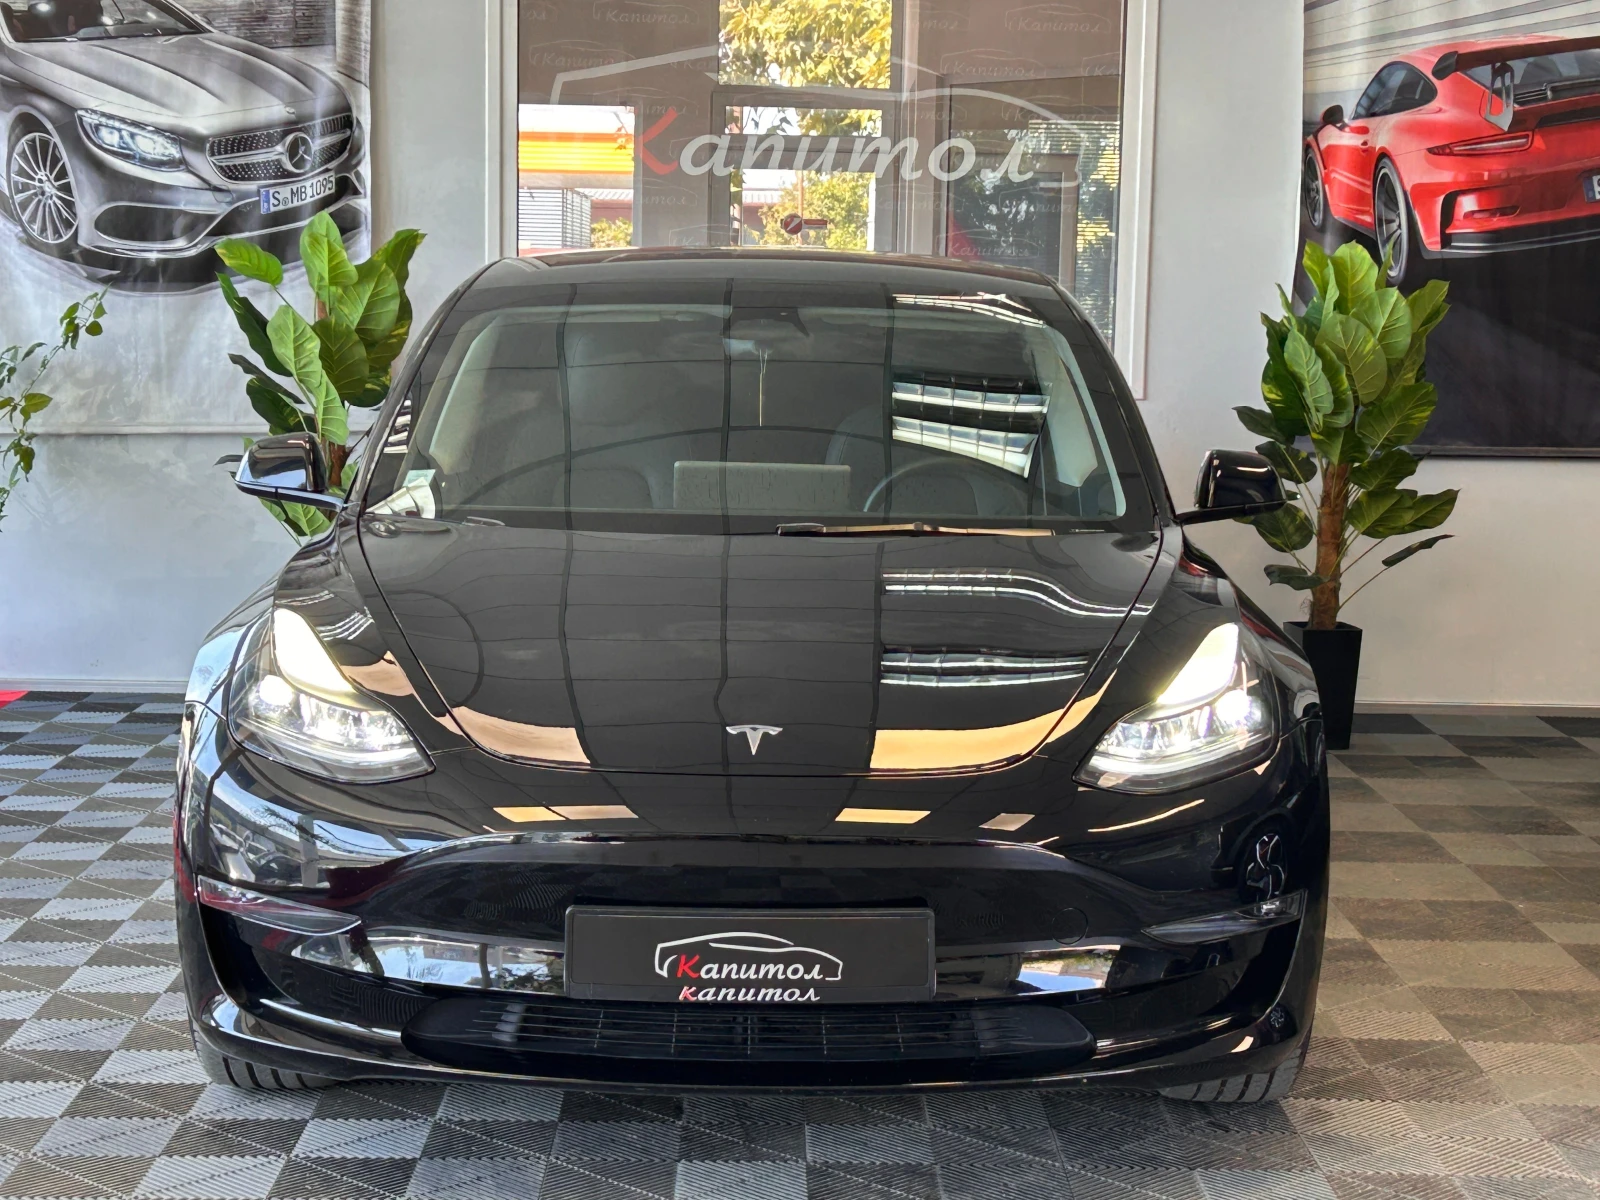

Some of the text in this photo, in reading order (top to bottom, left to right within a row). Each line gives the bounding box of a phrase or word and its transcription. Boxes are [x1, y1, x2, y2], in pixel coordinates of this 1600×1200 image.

[271, 174, 334, 207] S MB 1095
[676, 954, 823, 980] Капитол
